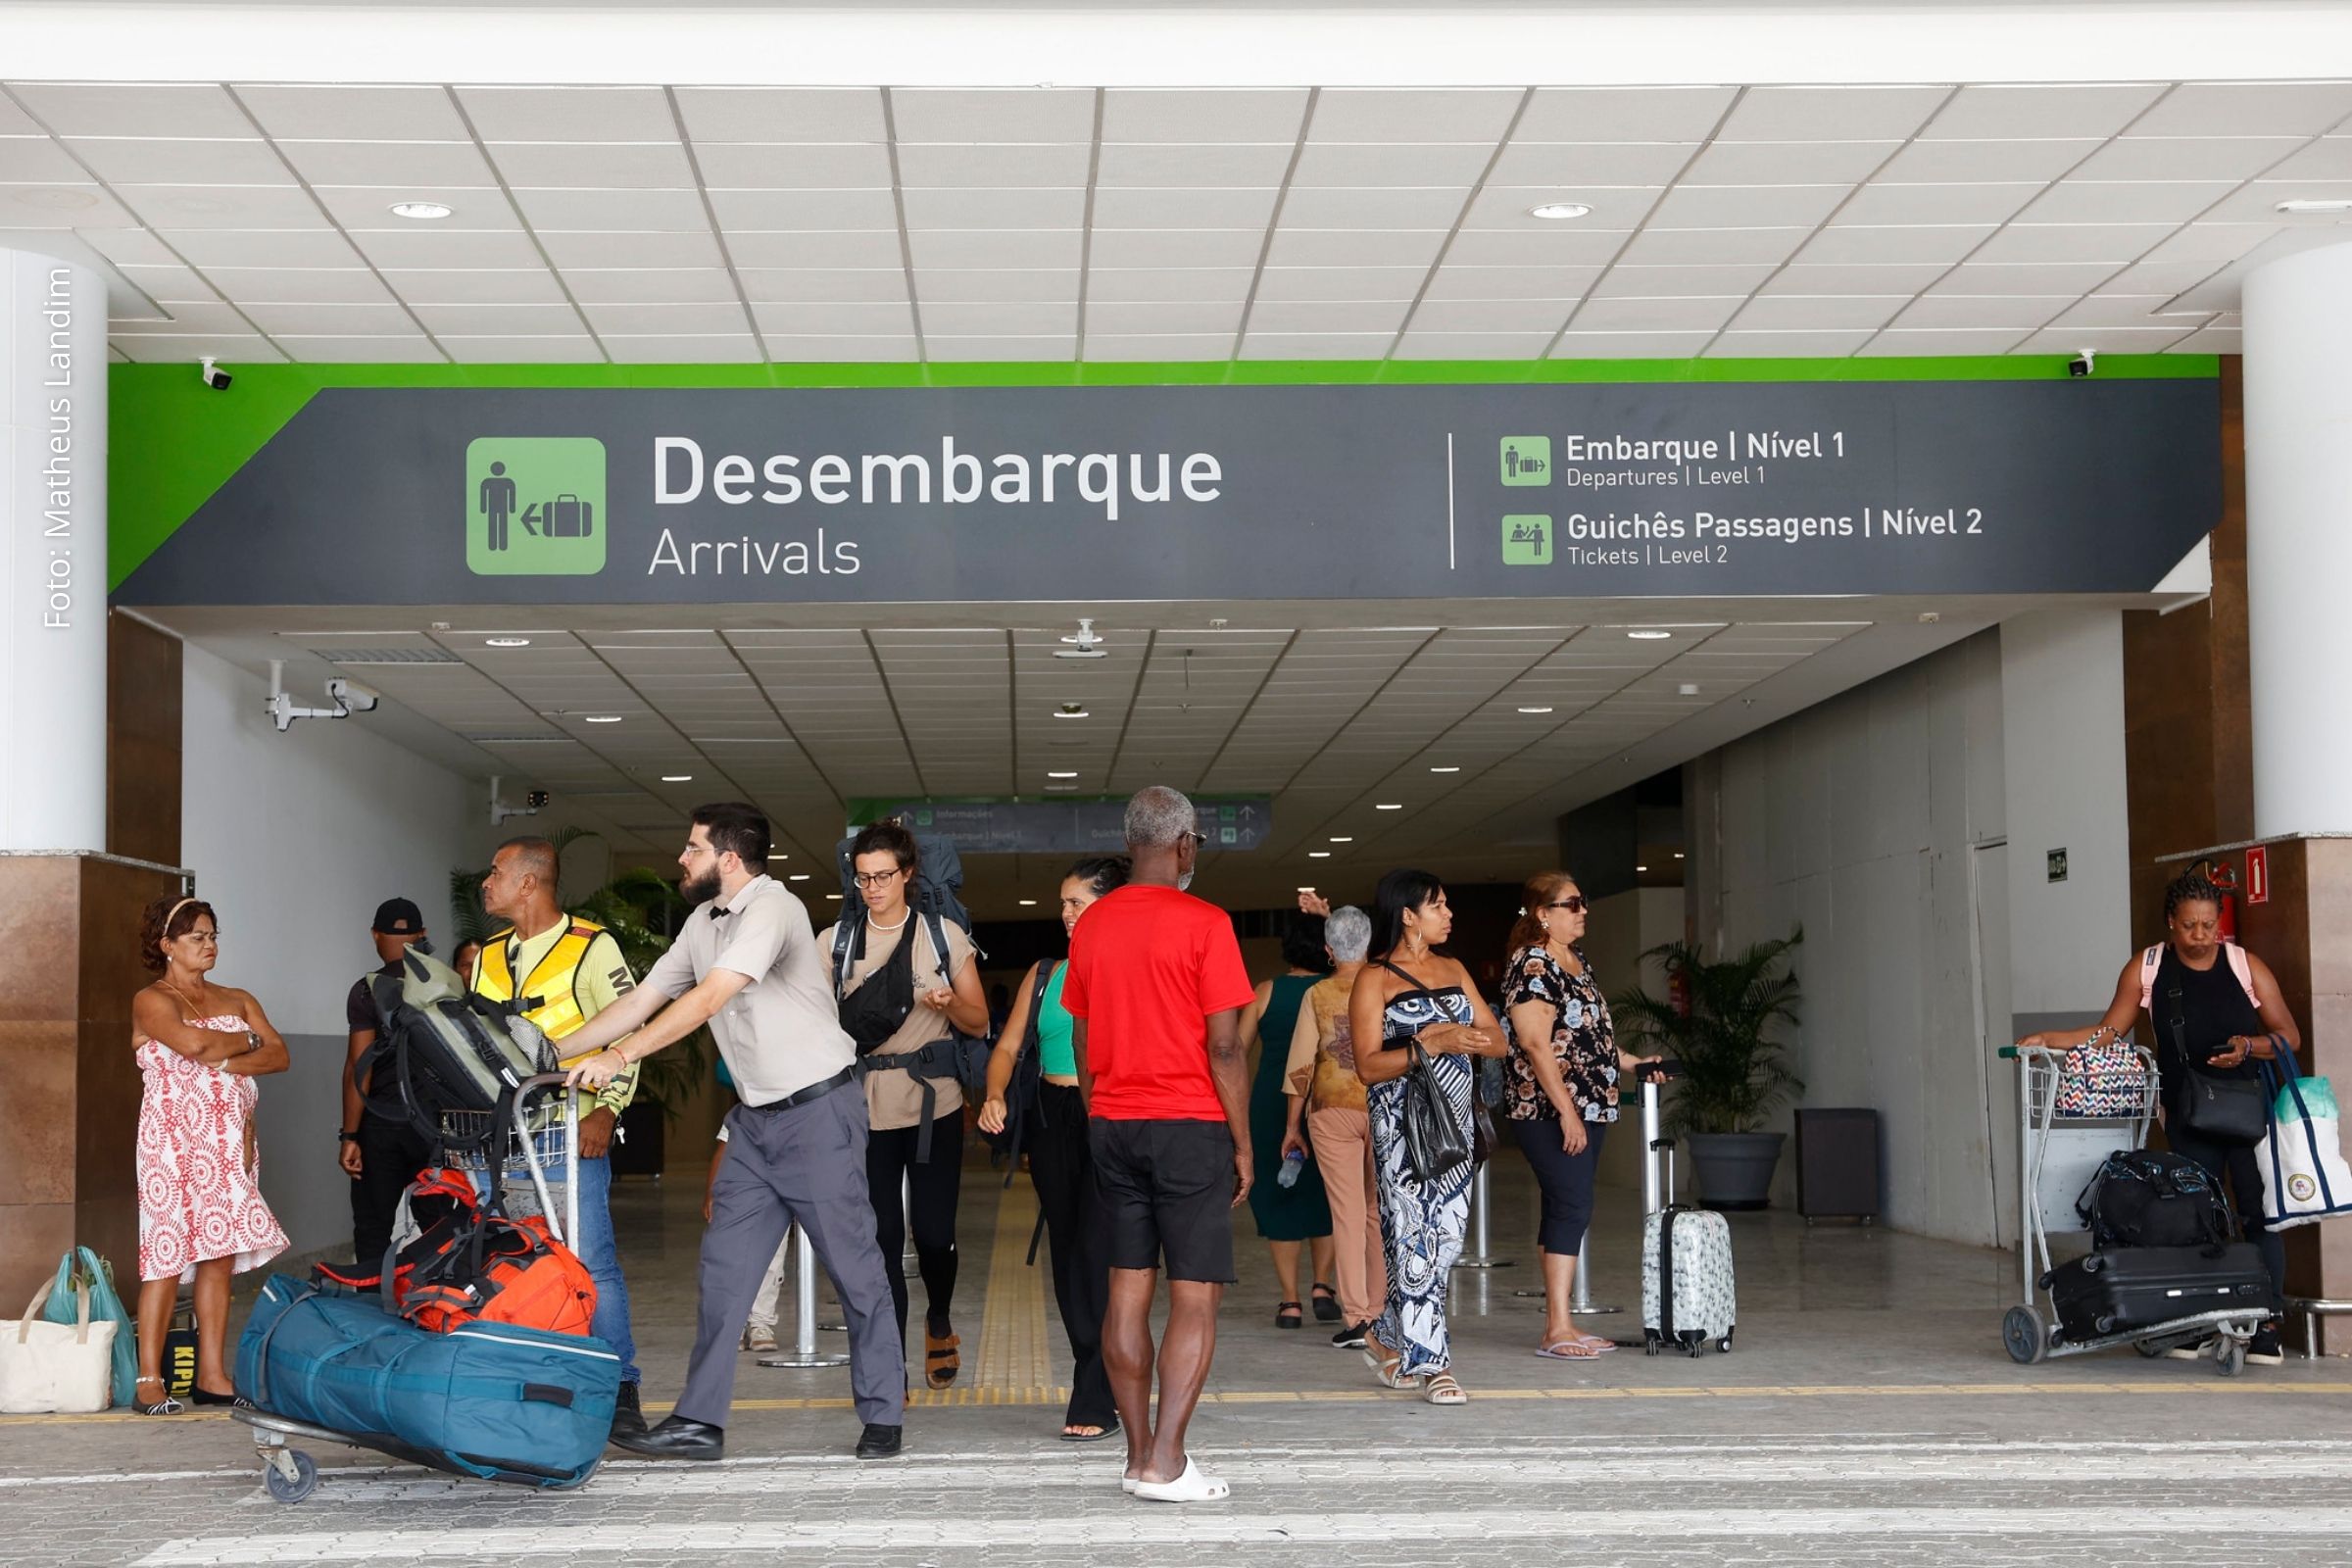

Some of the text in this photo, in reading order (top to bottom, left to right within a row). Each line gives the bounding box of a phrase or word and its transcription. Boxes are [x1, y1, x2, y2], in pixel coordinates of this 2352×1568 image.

[1568, 435, 1718, 466] Embarque
[1747, 431, 1823, 459] Nível
[1833, 431, 1843, 458] 1
[654, 435, 1222, 520] Desembarque
[1567, 467, 1679, 491] Departures
[1697, 466, 1749, 485] Level
[1757, 466, 1765, 484] 1
[1568, 511, 1686, 540] Guichês
[1694, 512, 1854, 544] Passagens
[1883, 508, 1958, 536] Nível
[1967, 509, 1983, 534] 2
[648, 527, 860, 575] Arrivals
[1568, 546, 1640, 565] Tickets
[1659, 546, 1711, 564] Level
[1717, 545, 1728, 564] 2
